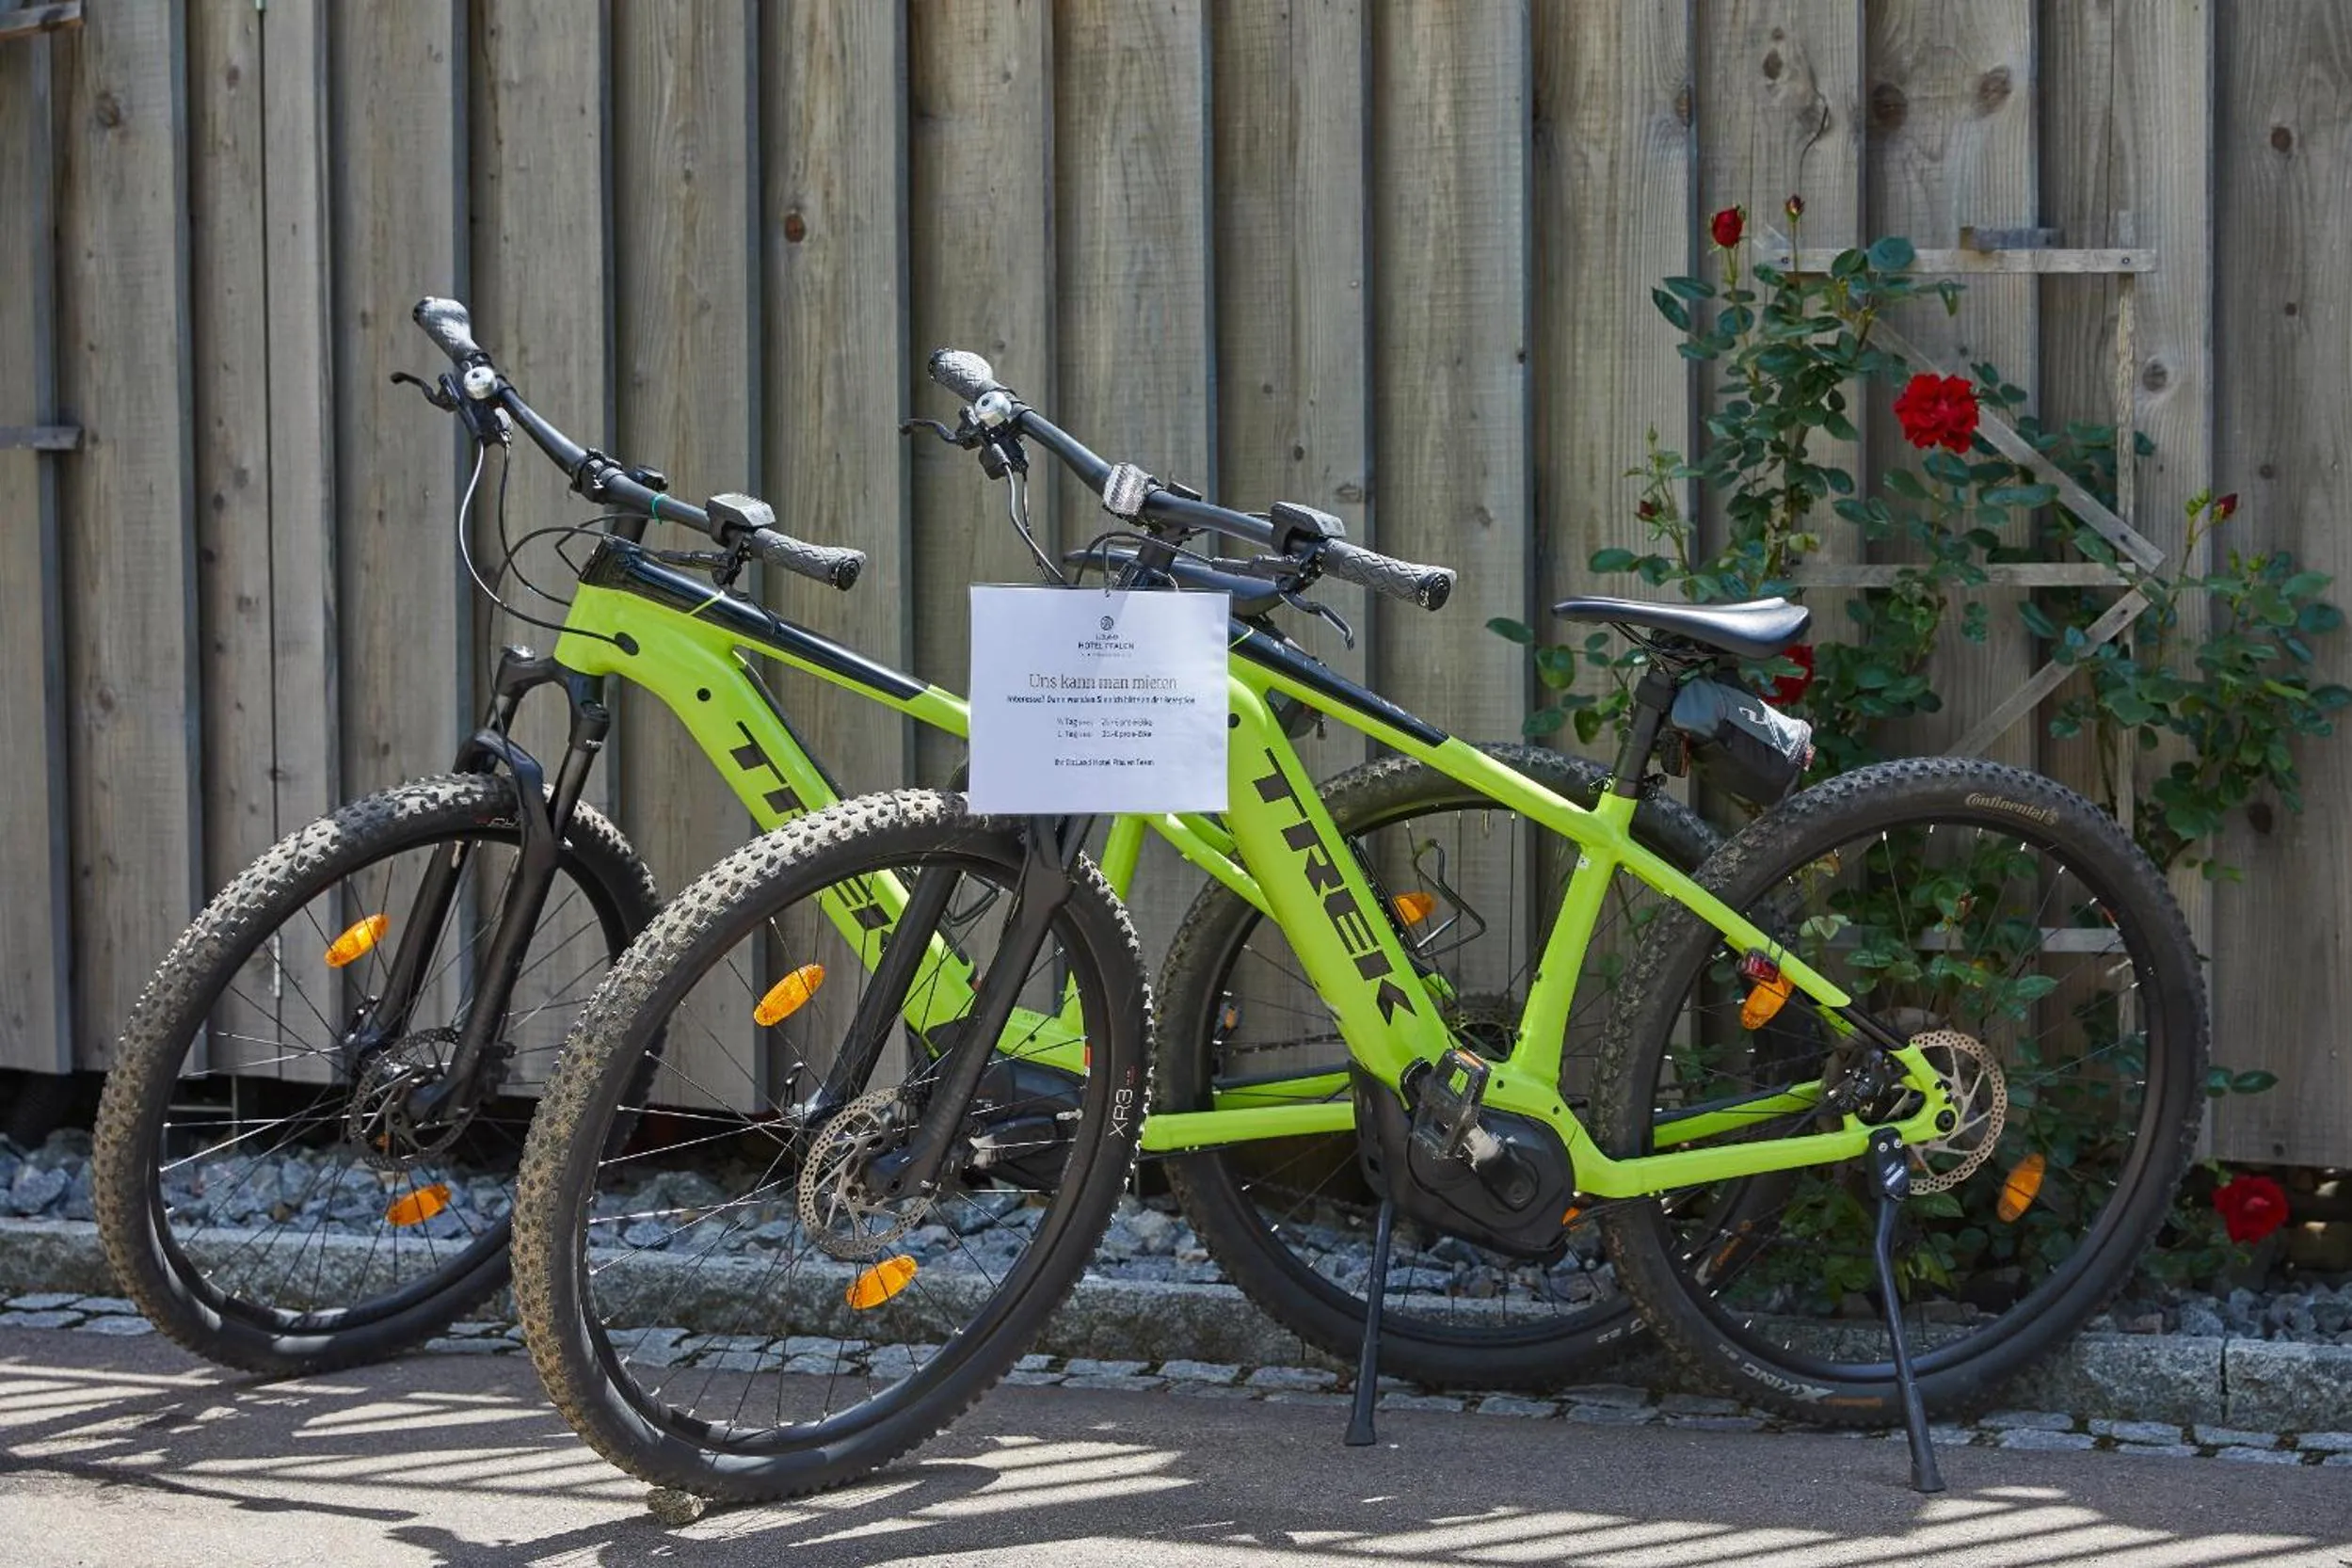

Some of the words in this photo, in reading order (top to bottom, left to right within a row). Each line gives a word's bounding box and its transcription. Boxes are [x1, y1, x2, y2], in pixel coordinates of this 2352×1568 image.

[1029, 673, 1058, 688] Uns
[1061, 673, 1096, 689] kann
[1098, 678, 1128, 689] man
[1253, 747, 1417, 1026] TREK
[1108, 1088, 1133, 1138] XR3
